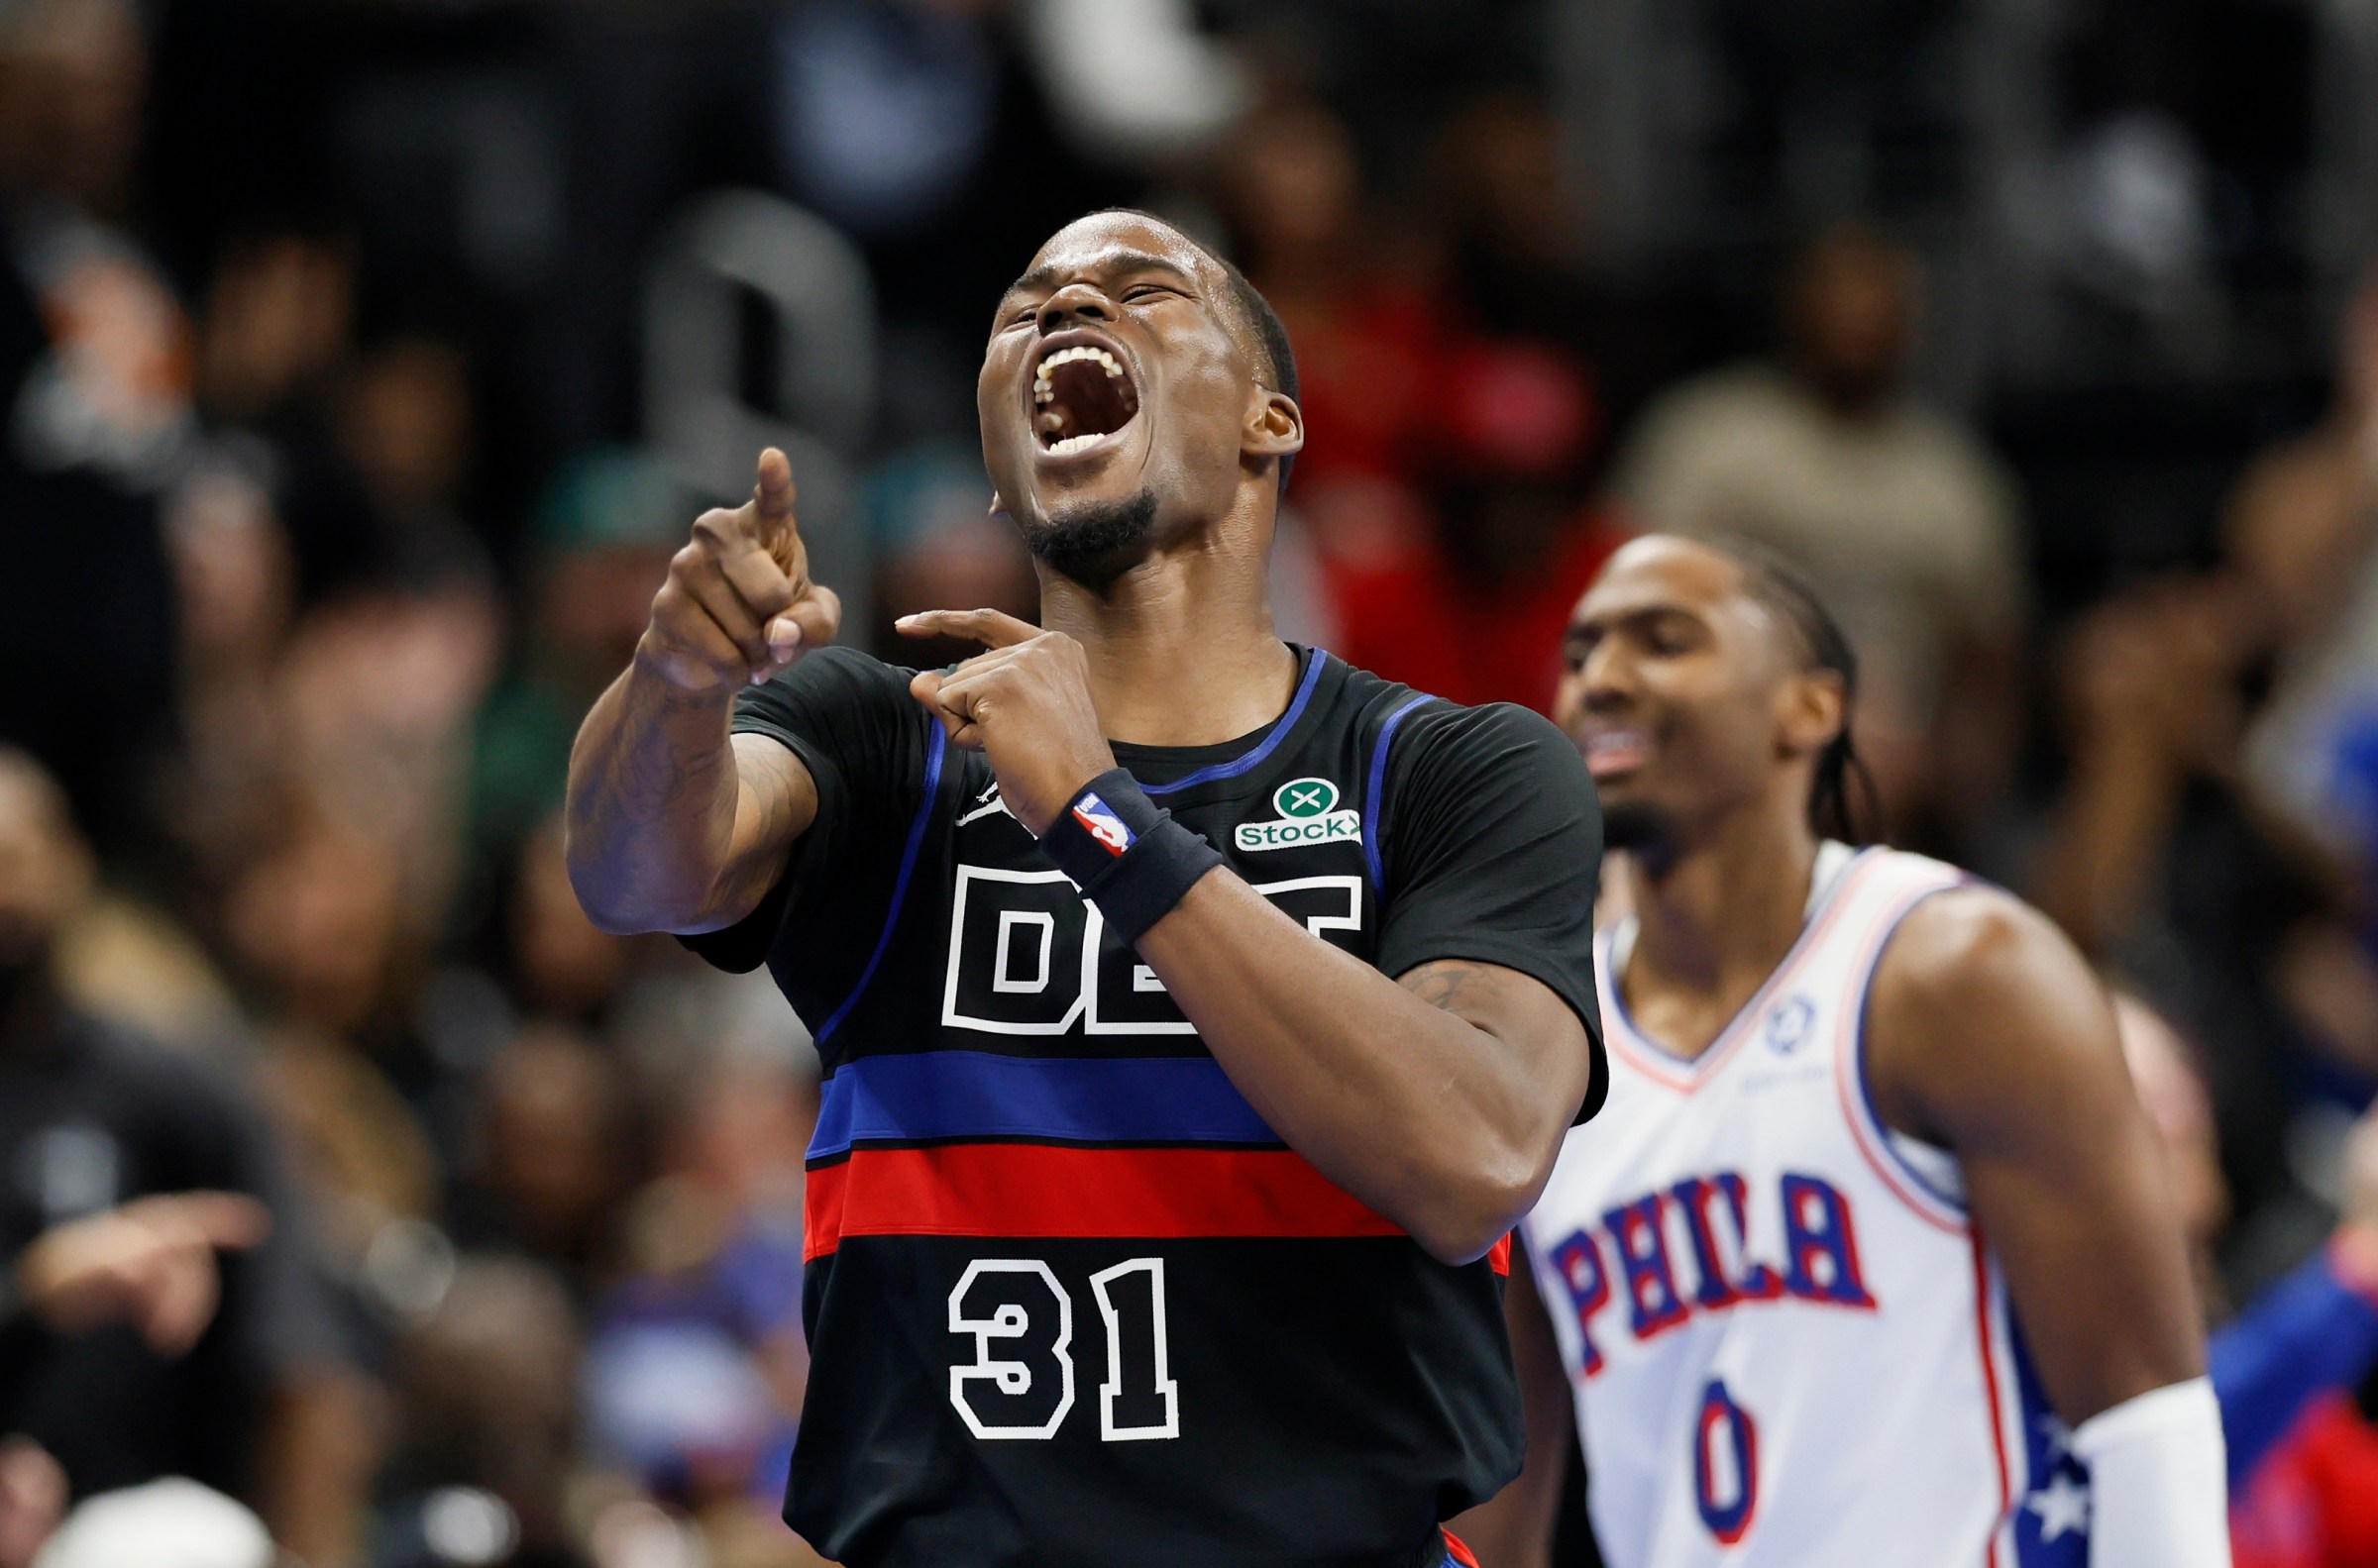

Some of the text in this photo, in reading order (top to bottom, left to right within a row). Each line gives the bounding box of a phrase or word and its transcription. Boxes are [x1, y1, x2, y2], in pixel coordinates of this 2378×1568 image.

[1079, 792, 1100, 813] NBA
[948, 1257, 1180, 1442] 31
[1550, 1172, 1880, 1378] PHILA
[1693, 1378, 1759, 1546] 0
